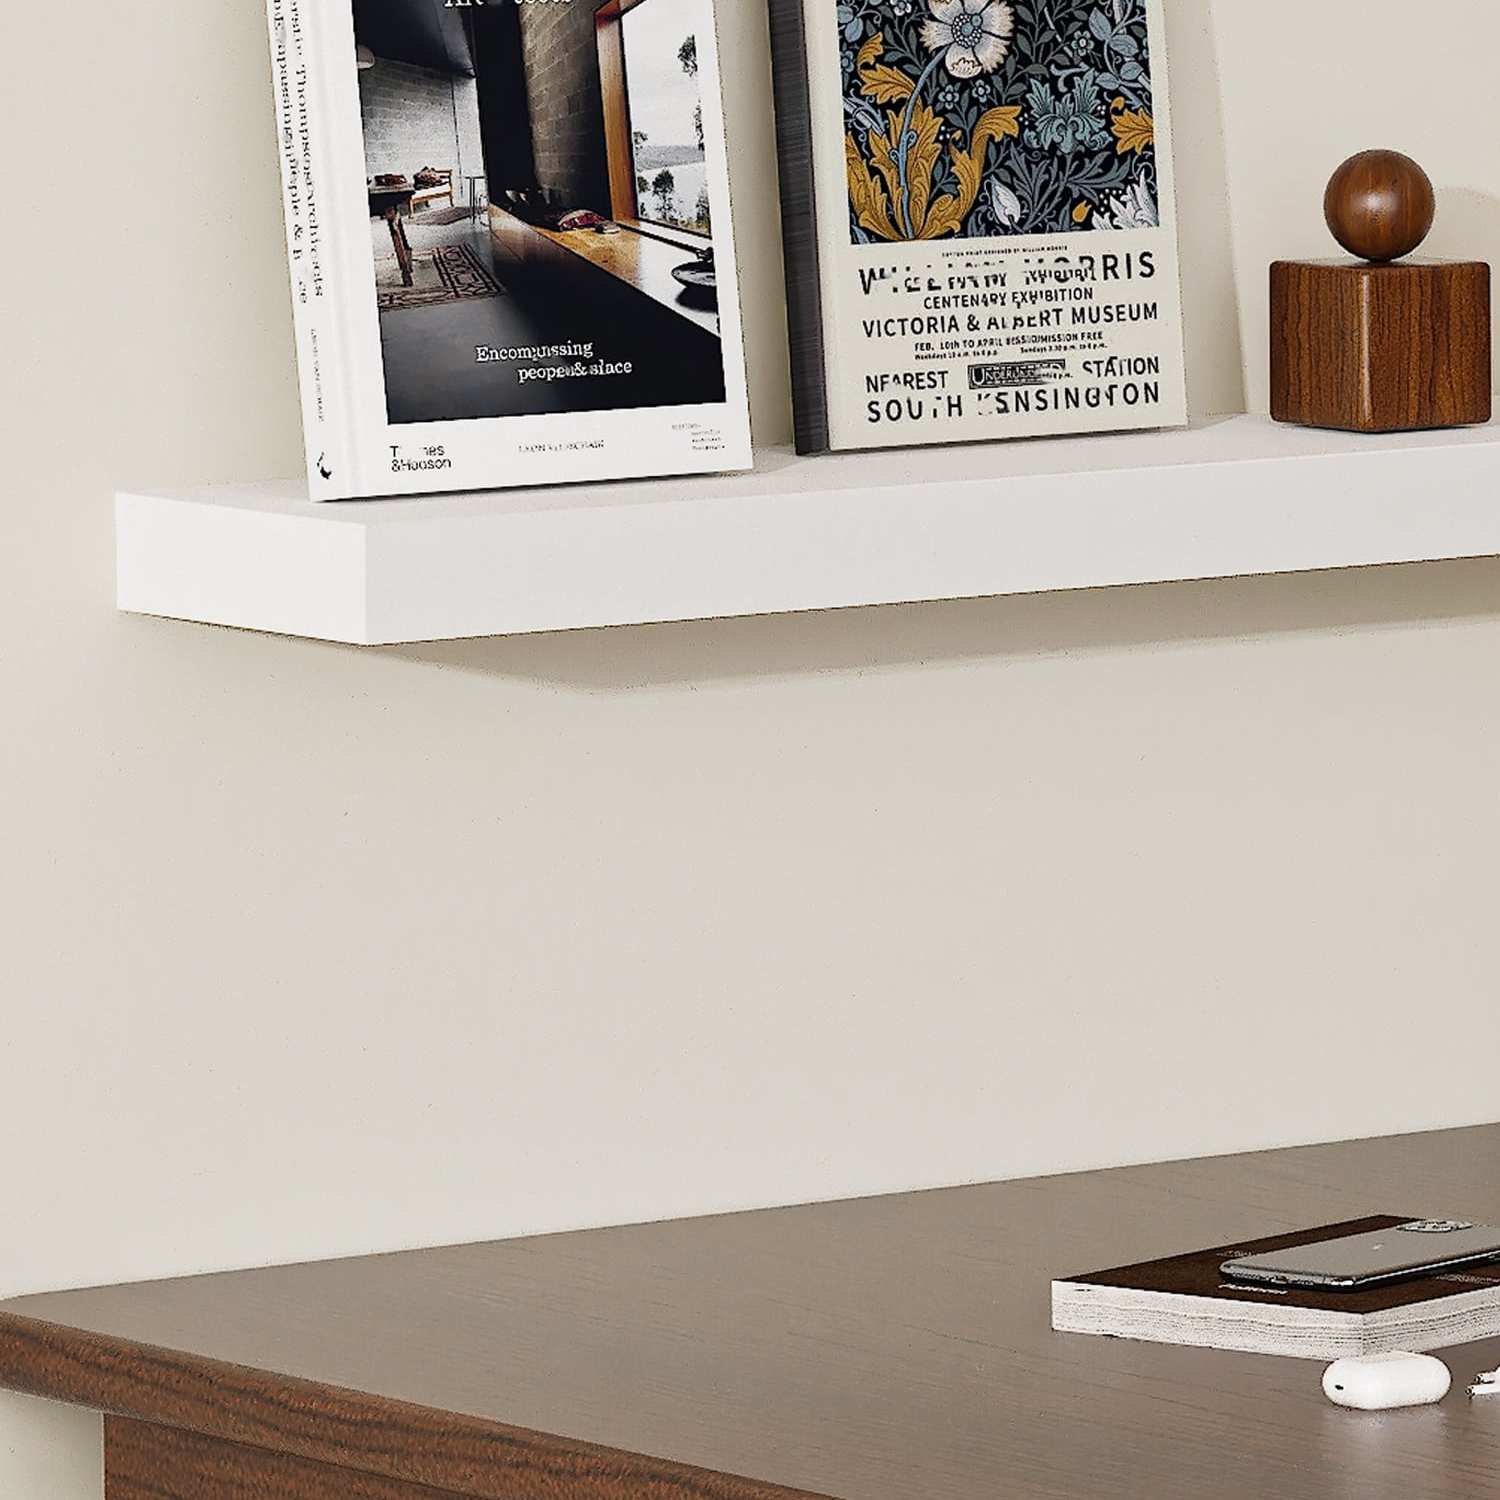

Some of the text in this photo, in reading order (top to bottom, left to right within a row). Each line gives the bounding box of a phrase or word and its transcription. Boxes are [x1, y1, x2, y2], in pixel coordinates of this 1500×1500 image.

[863, 315, 959, 338] VICTORIA
[967, 314, 980, 331] &
[1072, 302, 1158, 324] MUSEUM
